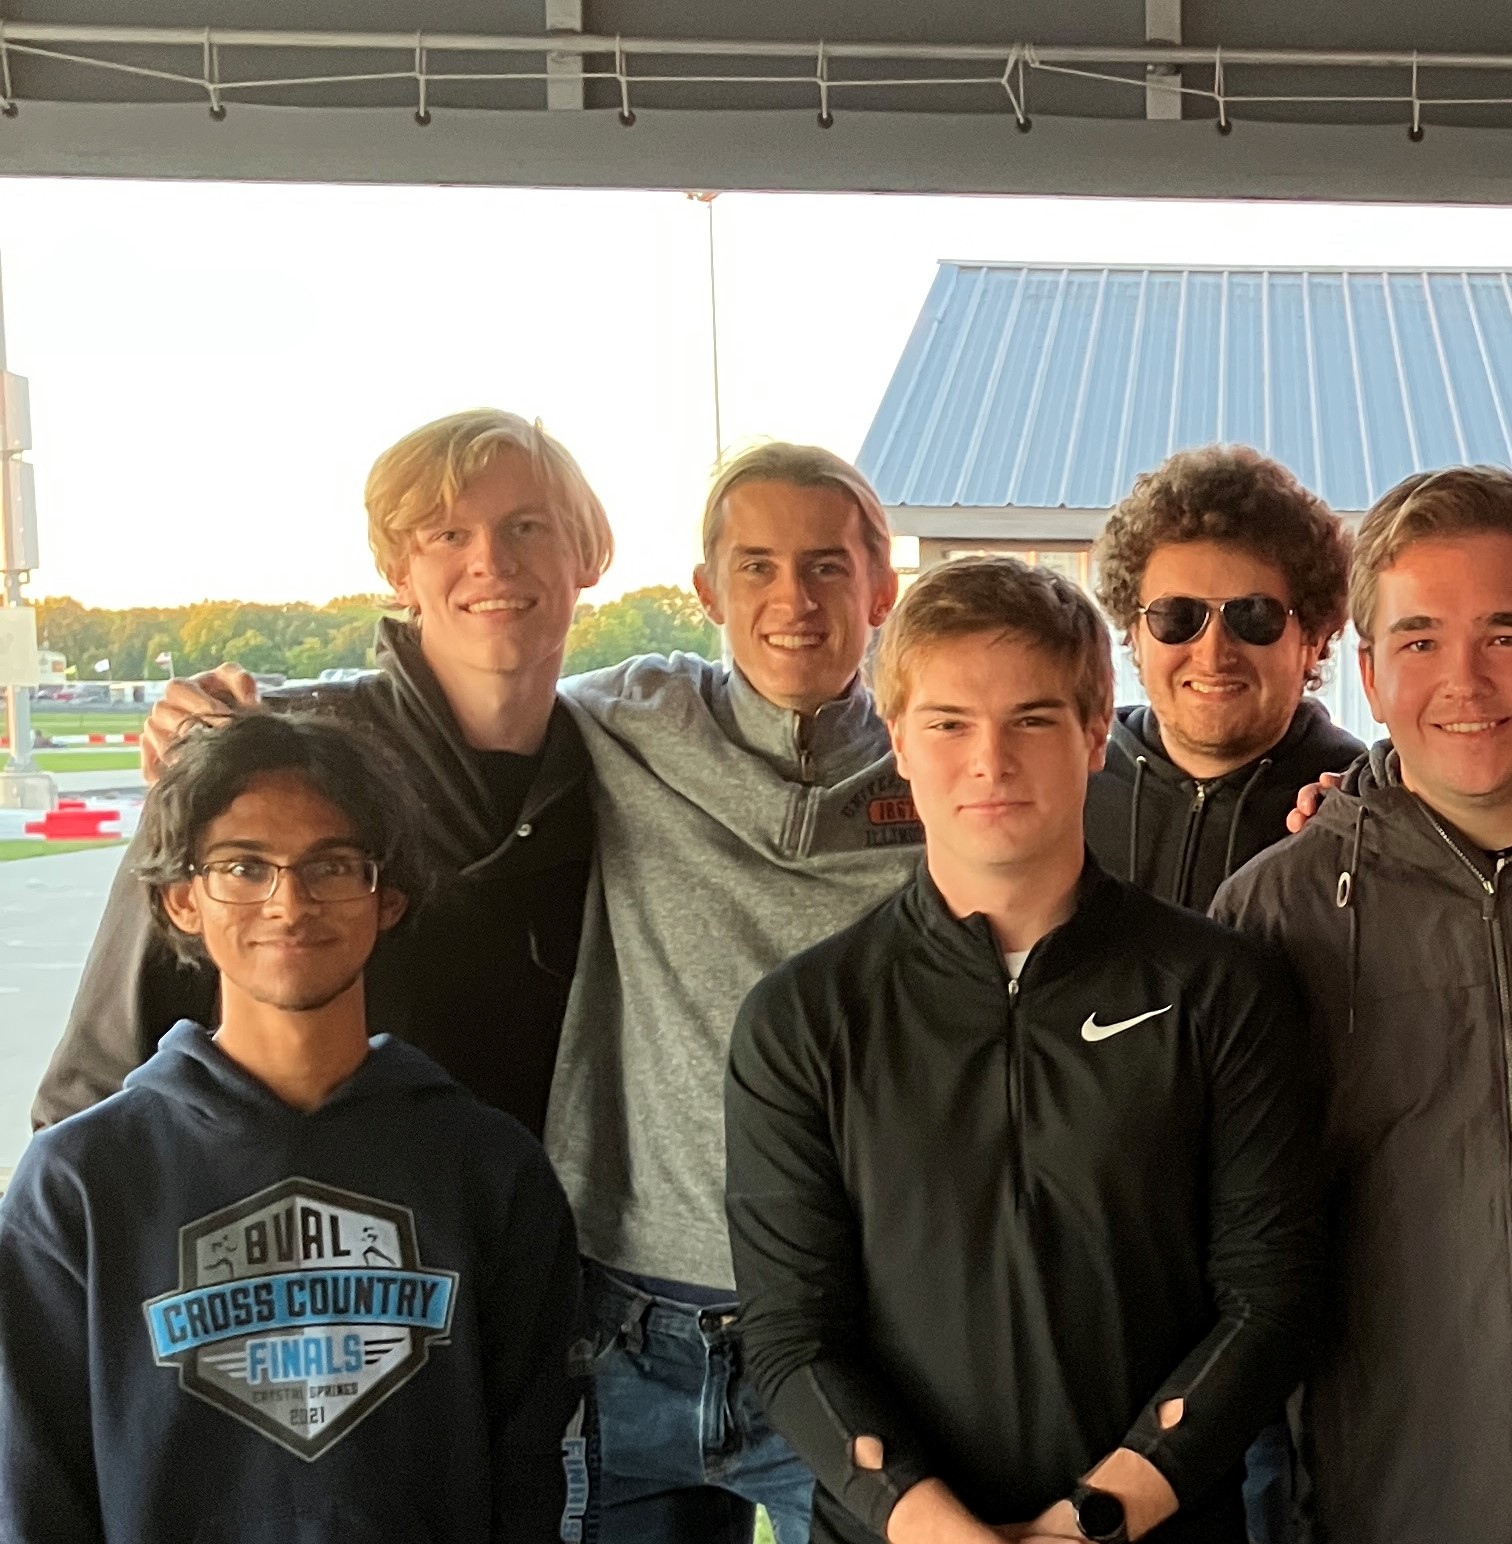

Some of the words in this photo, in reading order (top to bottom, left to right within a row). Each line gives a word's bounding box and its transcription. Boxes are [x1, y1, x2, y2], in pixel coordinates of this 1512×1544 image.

[245, 1206, 350, 1265] BVAL
[163, 1282, 276, 1345] CROSS
[286, 1276, 439, 1321] COUNTRY
[250, 1333, 363, 1382] FINALS
[290, 1406, 325, 1426] 2021
